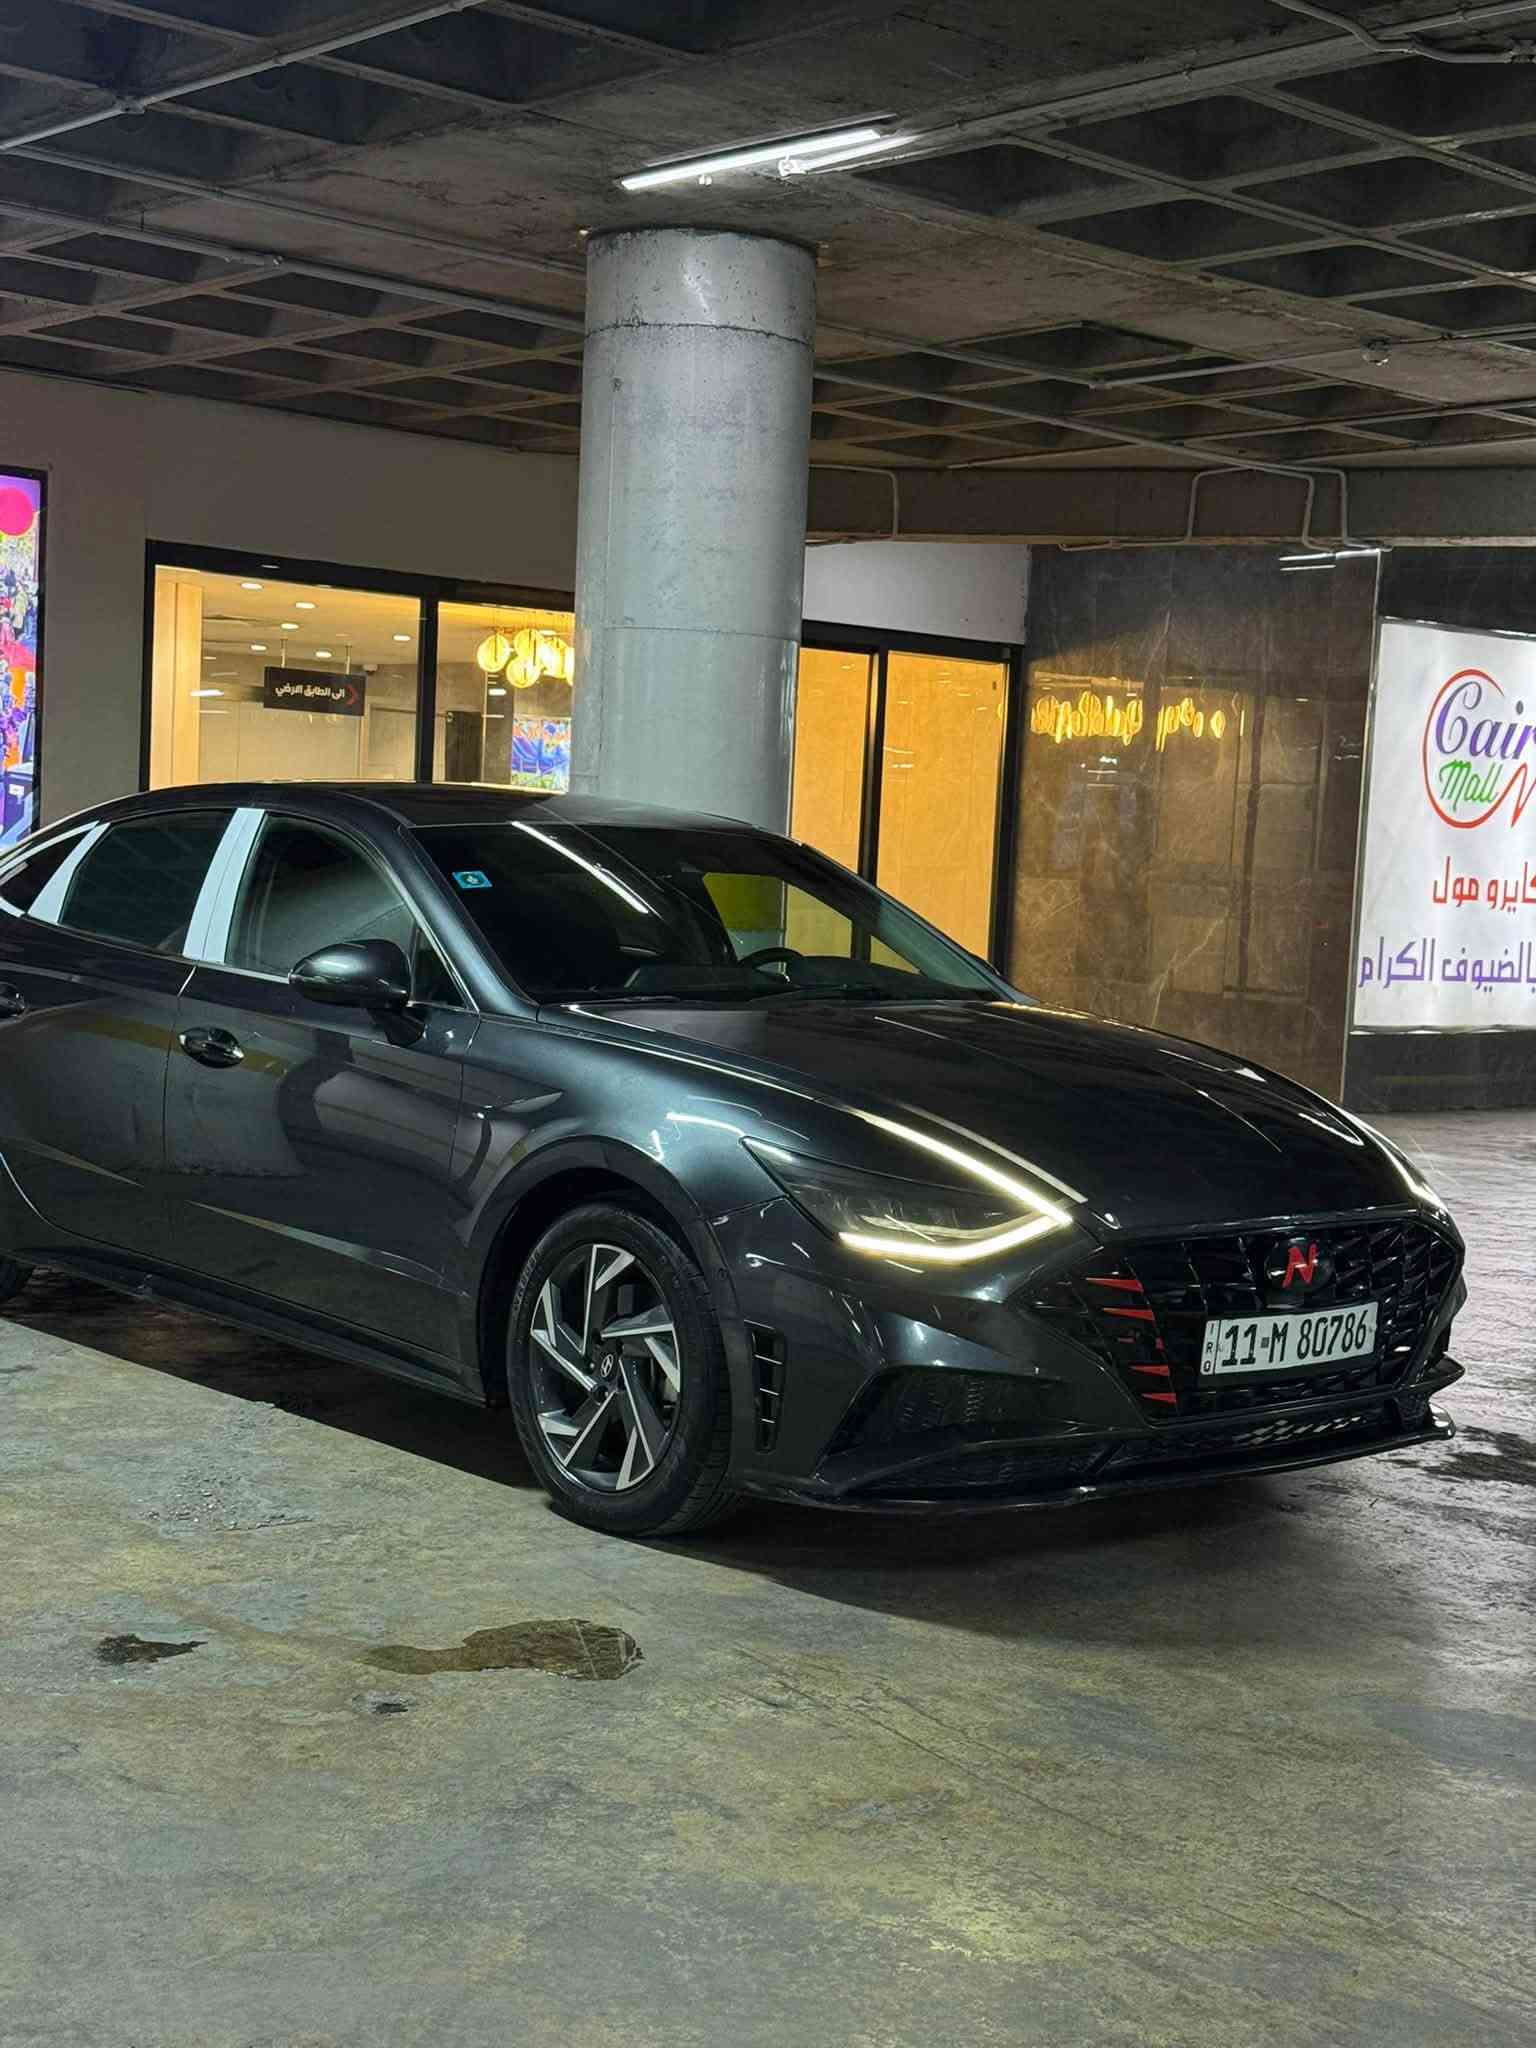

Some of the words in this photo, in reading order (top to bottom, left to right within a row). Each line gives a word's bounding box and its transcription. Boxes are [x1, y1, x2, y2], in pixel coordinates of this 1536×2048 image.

[303, 685, 331, 698] الطابق
[1438, 758, 1504, 812] Mall
[1432, 855, 1480, 908] مول
[1358, 936, 1436, 988] الكرام
[1282, 1243, 1319, 1288] N
[1297, 1309, 1369, 1360] 80786
